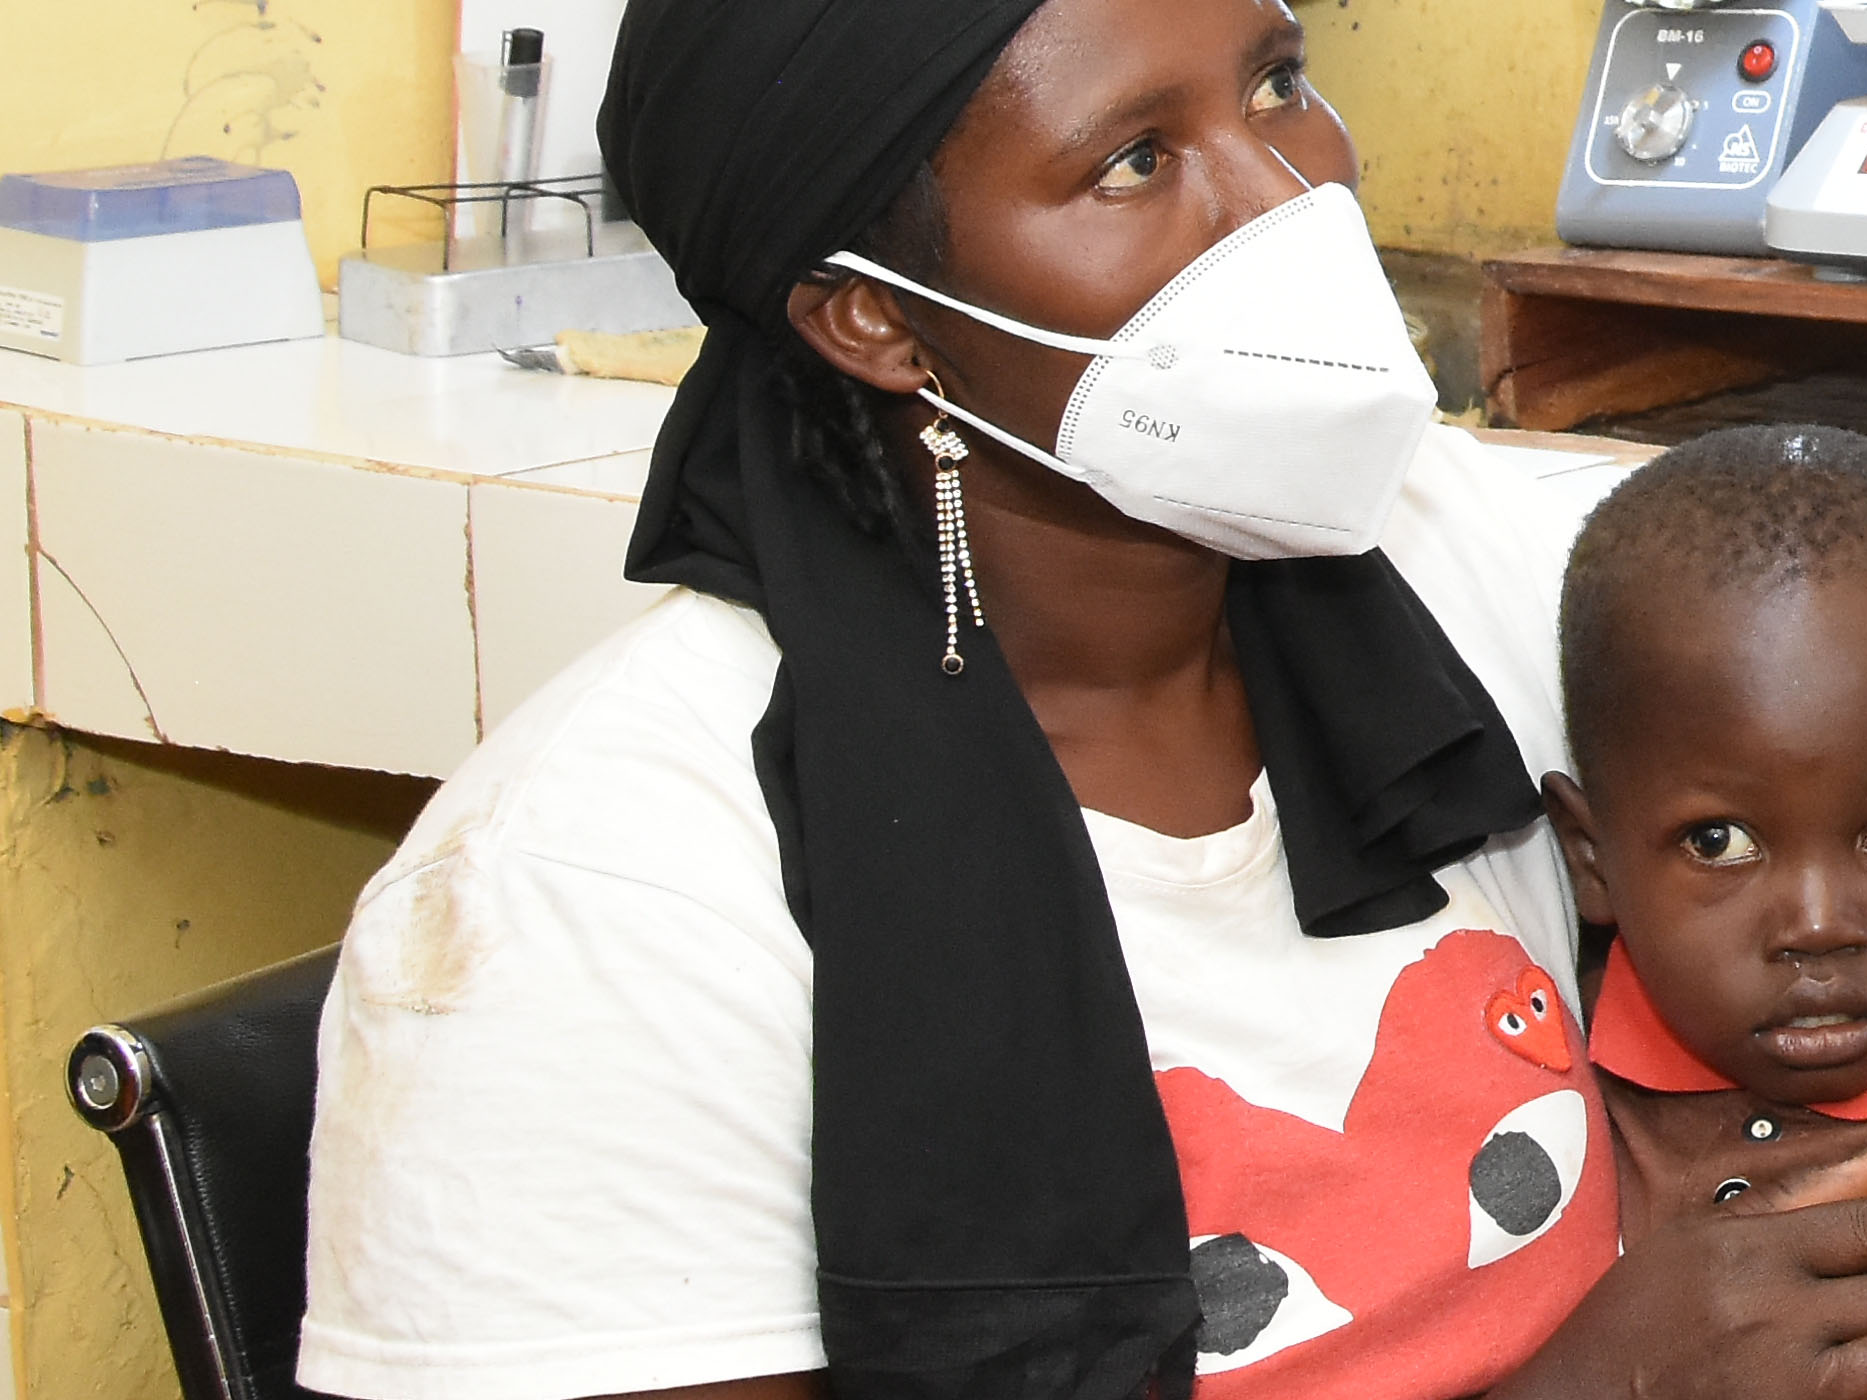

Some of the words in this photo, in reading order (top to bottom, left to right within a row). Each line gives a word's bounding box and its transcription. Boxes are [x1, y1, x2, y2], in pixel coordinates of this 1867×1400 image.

[1657, 29, 1704, 44] BM-16
[1743, 97, 1760, 107] ON
[1719, 161, 1758, 173] BIOTEC
[1118, 409, 1181, 443] KN95
